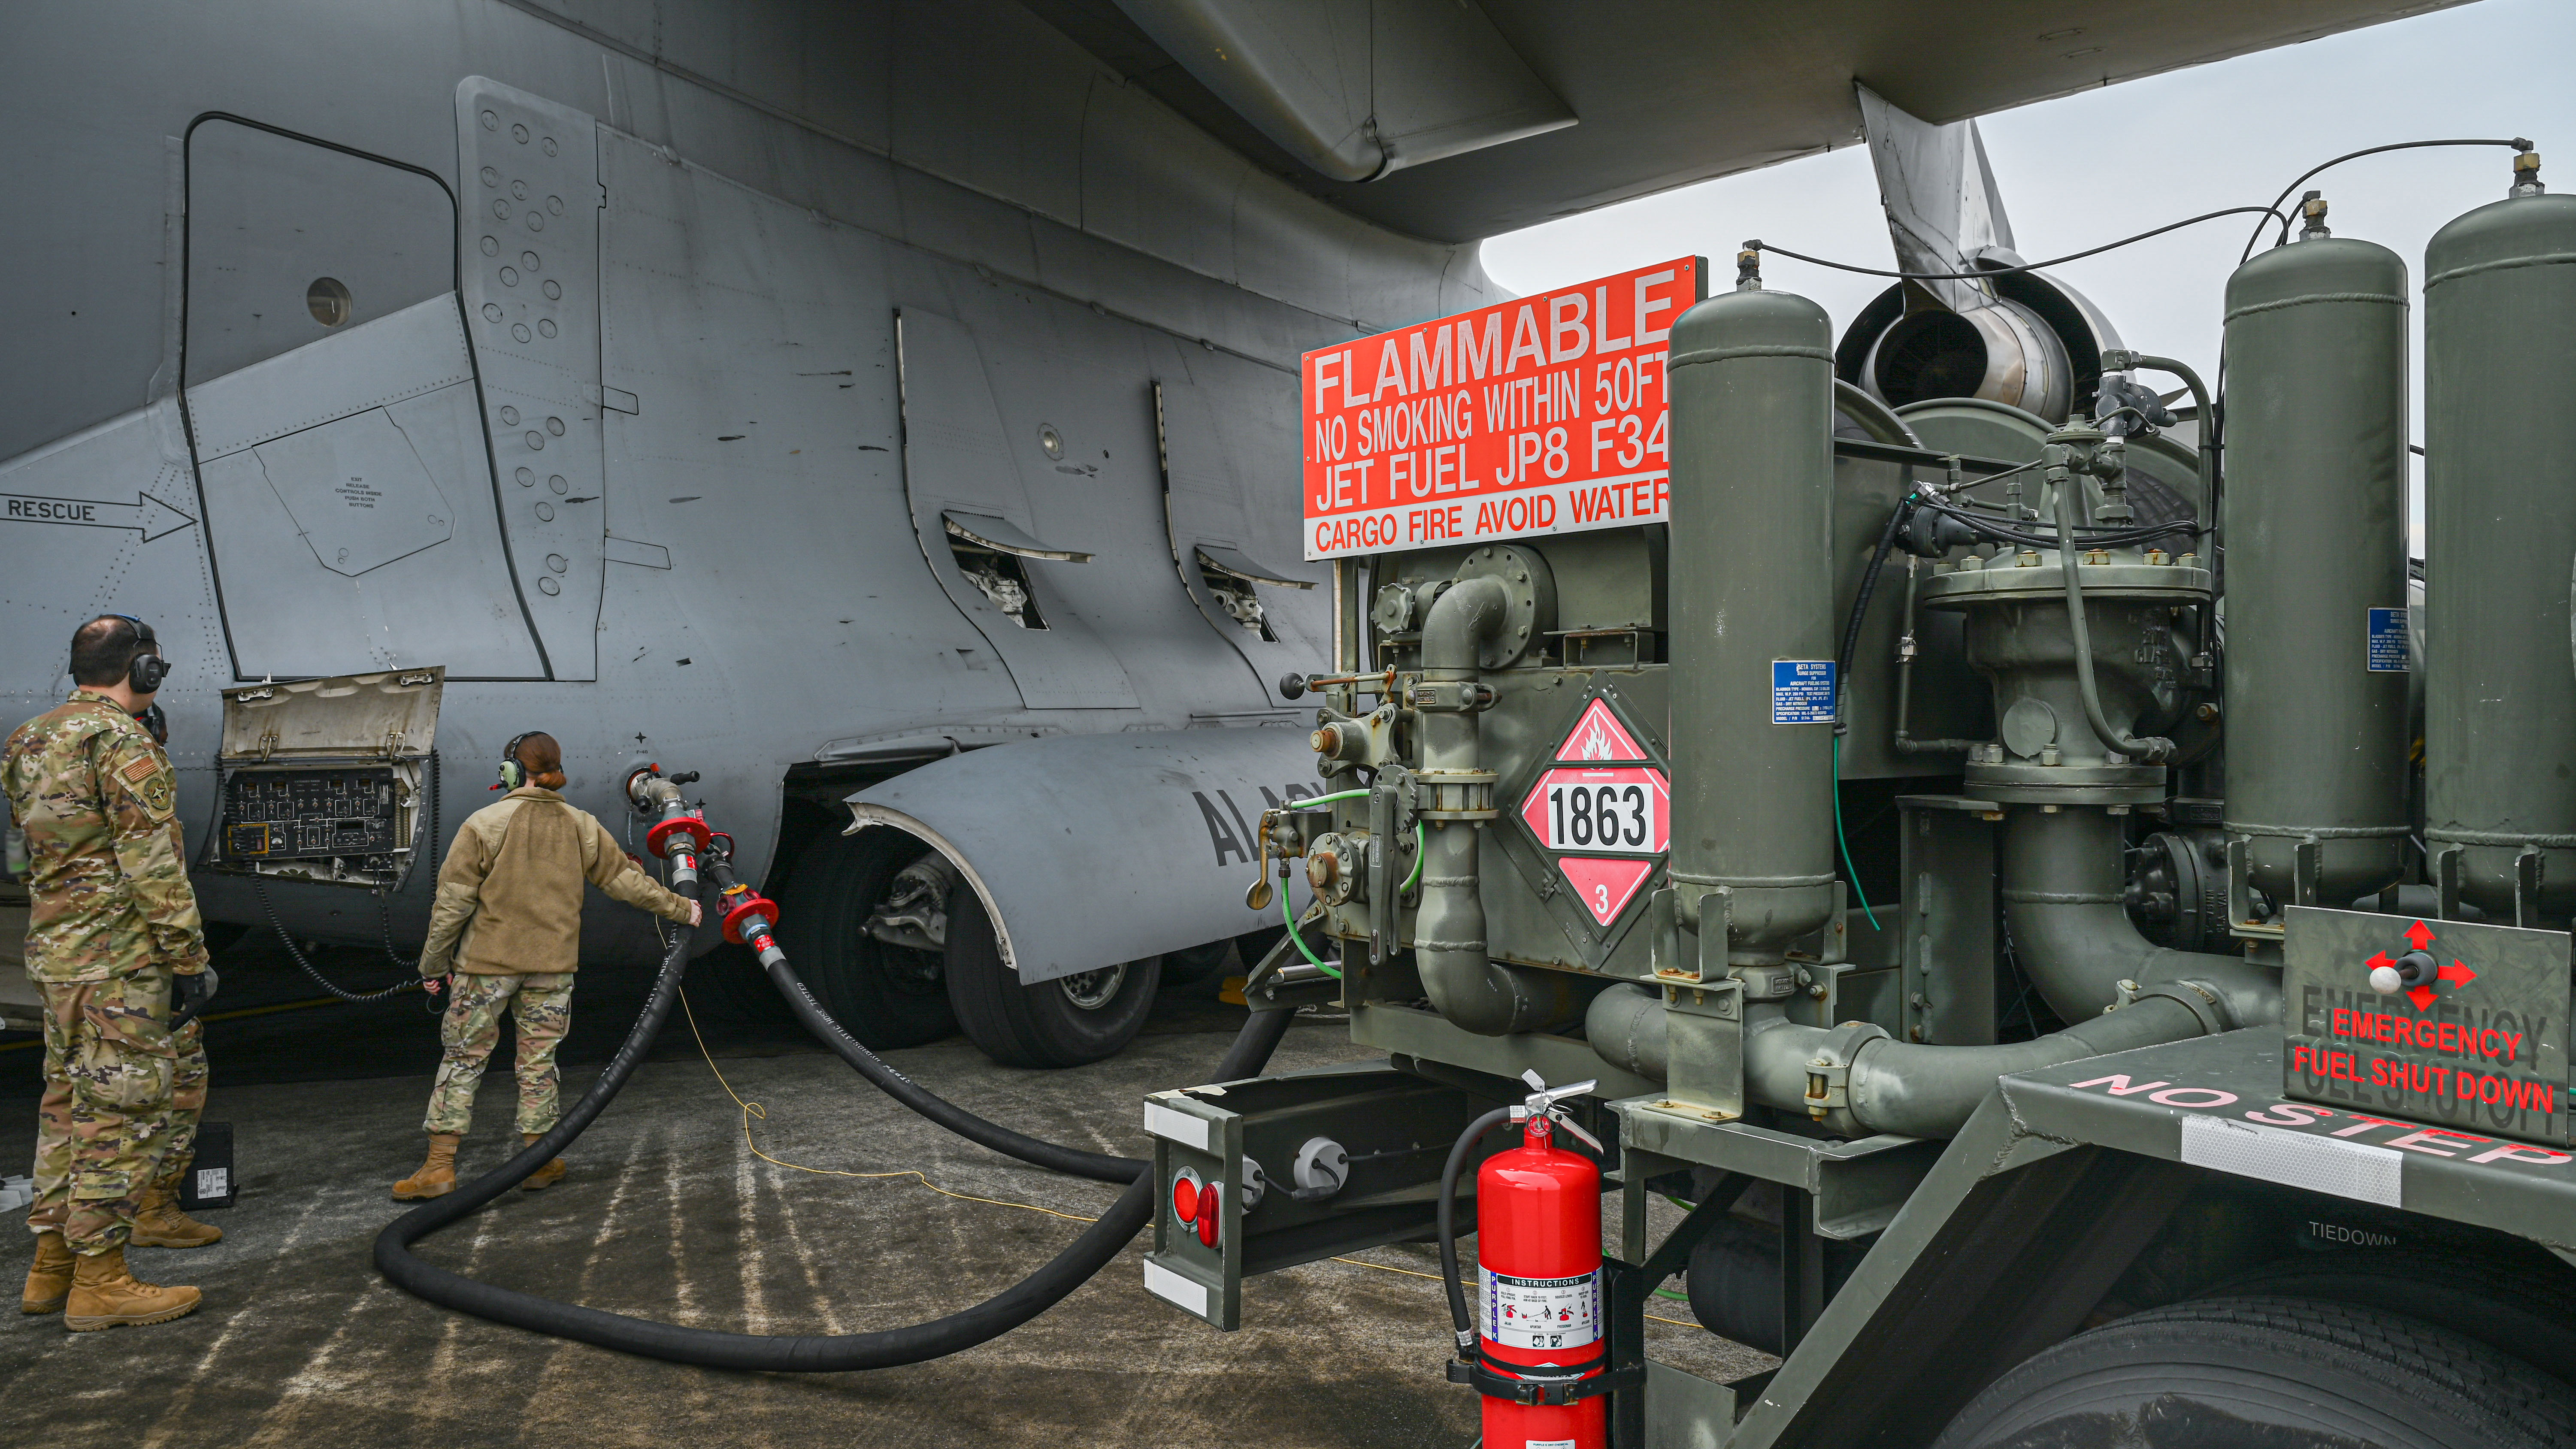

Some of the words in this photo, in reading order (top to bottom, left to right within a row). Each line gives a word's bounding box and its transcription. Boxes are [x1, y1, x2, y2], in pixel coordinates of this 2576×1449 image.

[1315, 269, 1674, 414] FLAMMABLE
[1316, 415, 1347, 463] NO
[1358, 389, 1472, 457] SMOKING
[1483, 368, 1580, 433] WITHIN
[1595, 350, 1668, 415] 50FT
[1316, 459, 1374, 512] JET
[1390, 443, 1479, 500] FUEL
[1496, 427, 1569, 487] JP8
[1592, 409, 1668, 473] F34
[9, 500, 95, 521] RESCUE
[1316, 513, 1397, 552] CARGO
[1409, 508, 1463, 542] FIRE
[1475, 494, 1556, 536] AVOID
[1570, 477, 1668, 524] WATER
[1551, 786, 1646, 846] 1863
[1595, 884, 1608, 914] 3
[797, 982, 817, 1006] TESTED
[816, 1008, 834, 1024] HOSE
[2334, 1009, 2522, 1060] EMERGENCY
[2294, 1046, 2364, 1083] FUEL
[2372, 1058, 2449, 1095] SHUT
[2458, 1072, 2553, 1113] DOWN
[2068, 1074, 2238, 1107] NO
[2245, 1104, 2573, 1164] STEP
[2309, 1221, 2396, 1246] TIEDOWN
[1511, 1278, 1579, 1287] INSTRUCTIONS
